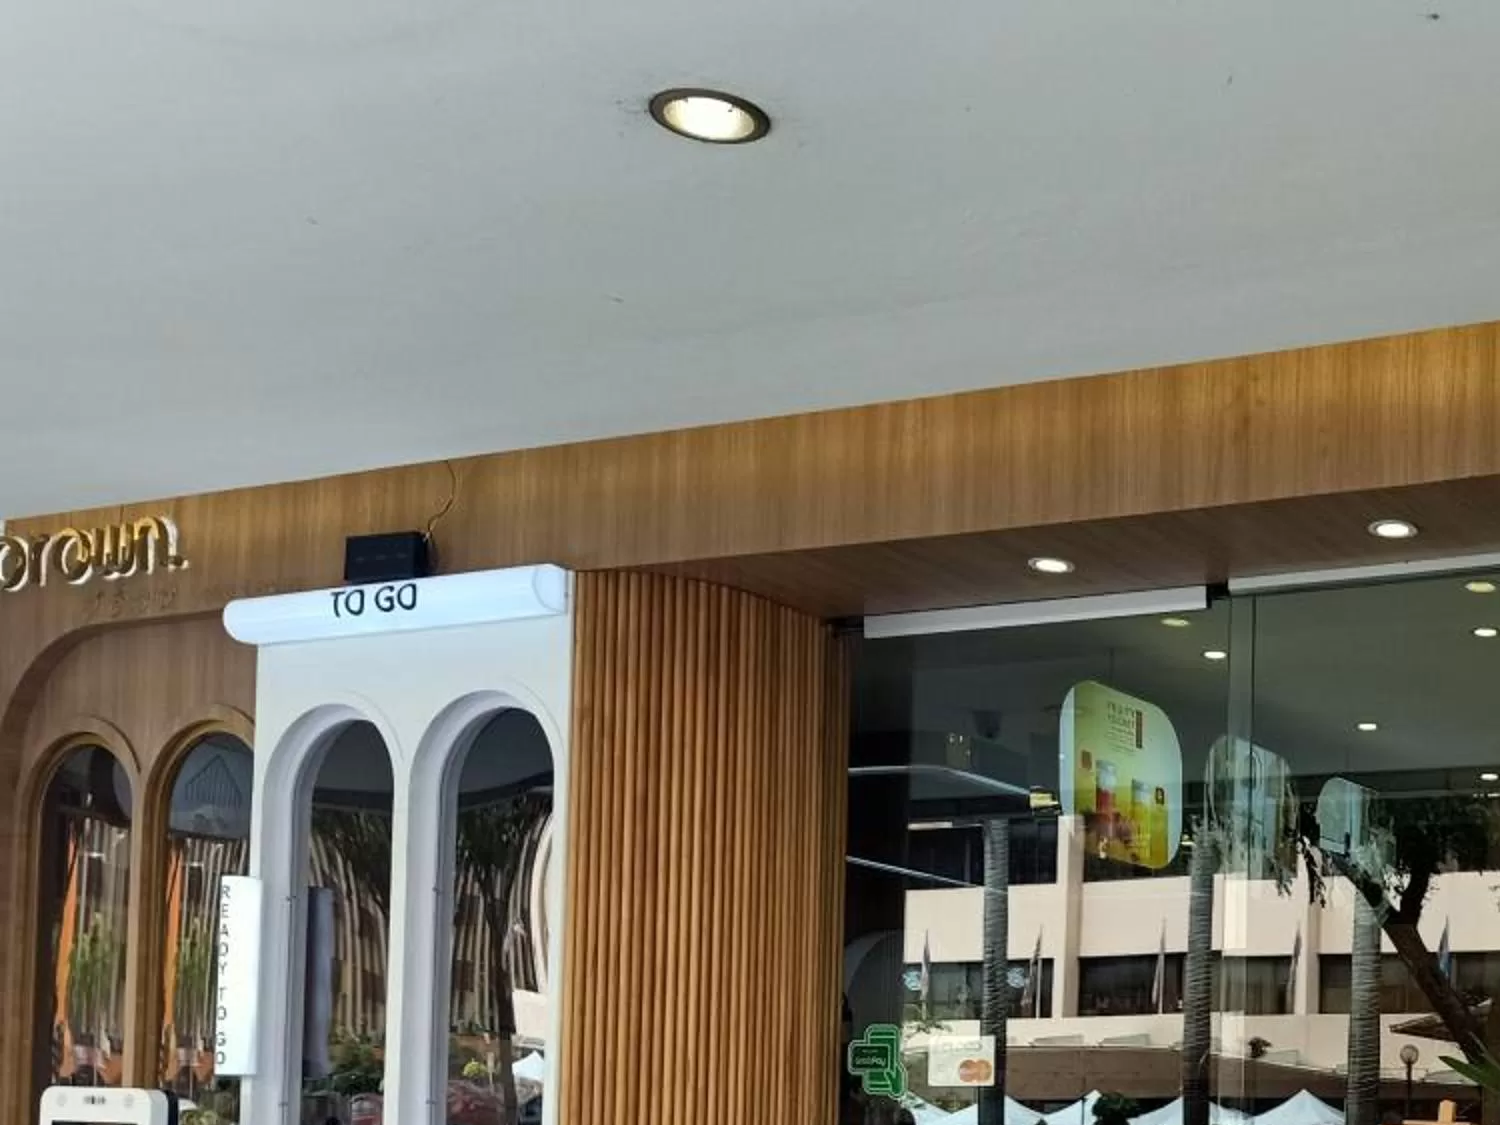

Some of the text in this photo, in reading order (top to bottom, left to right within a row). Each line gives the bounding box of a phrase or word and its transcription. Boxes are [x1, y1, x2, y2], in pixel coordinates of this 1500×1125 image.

[331, 582, 417, 618] TO GO
[215, 884, 231, 1066] READY TO GO
